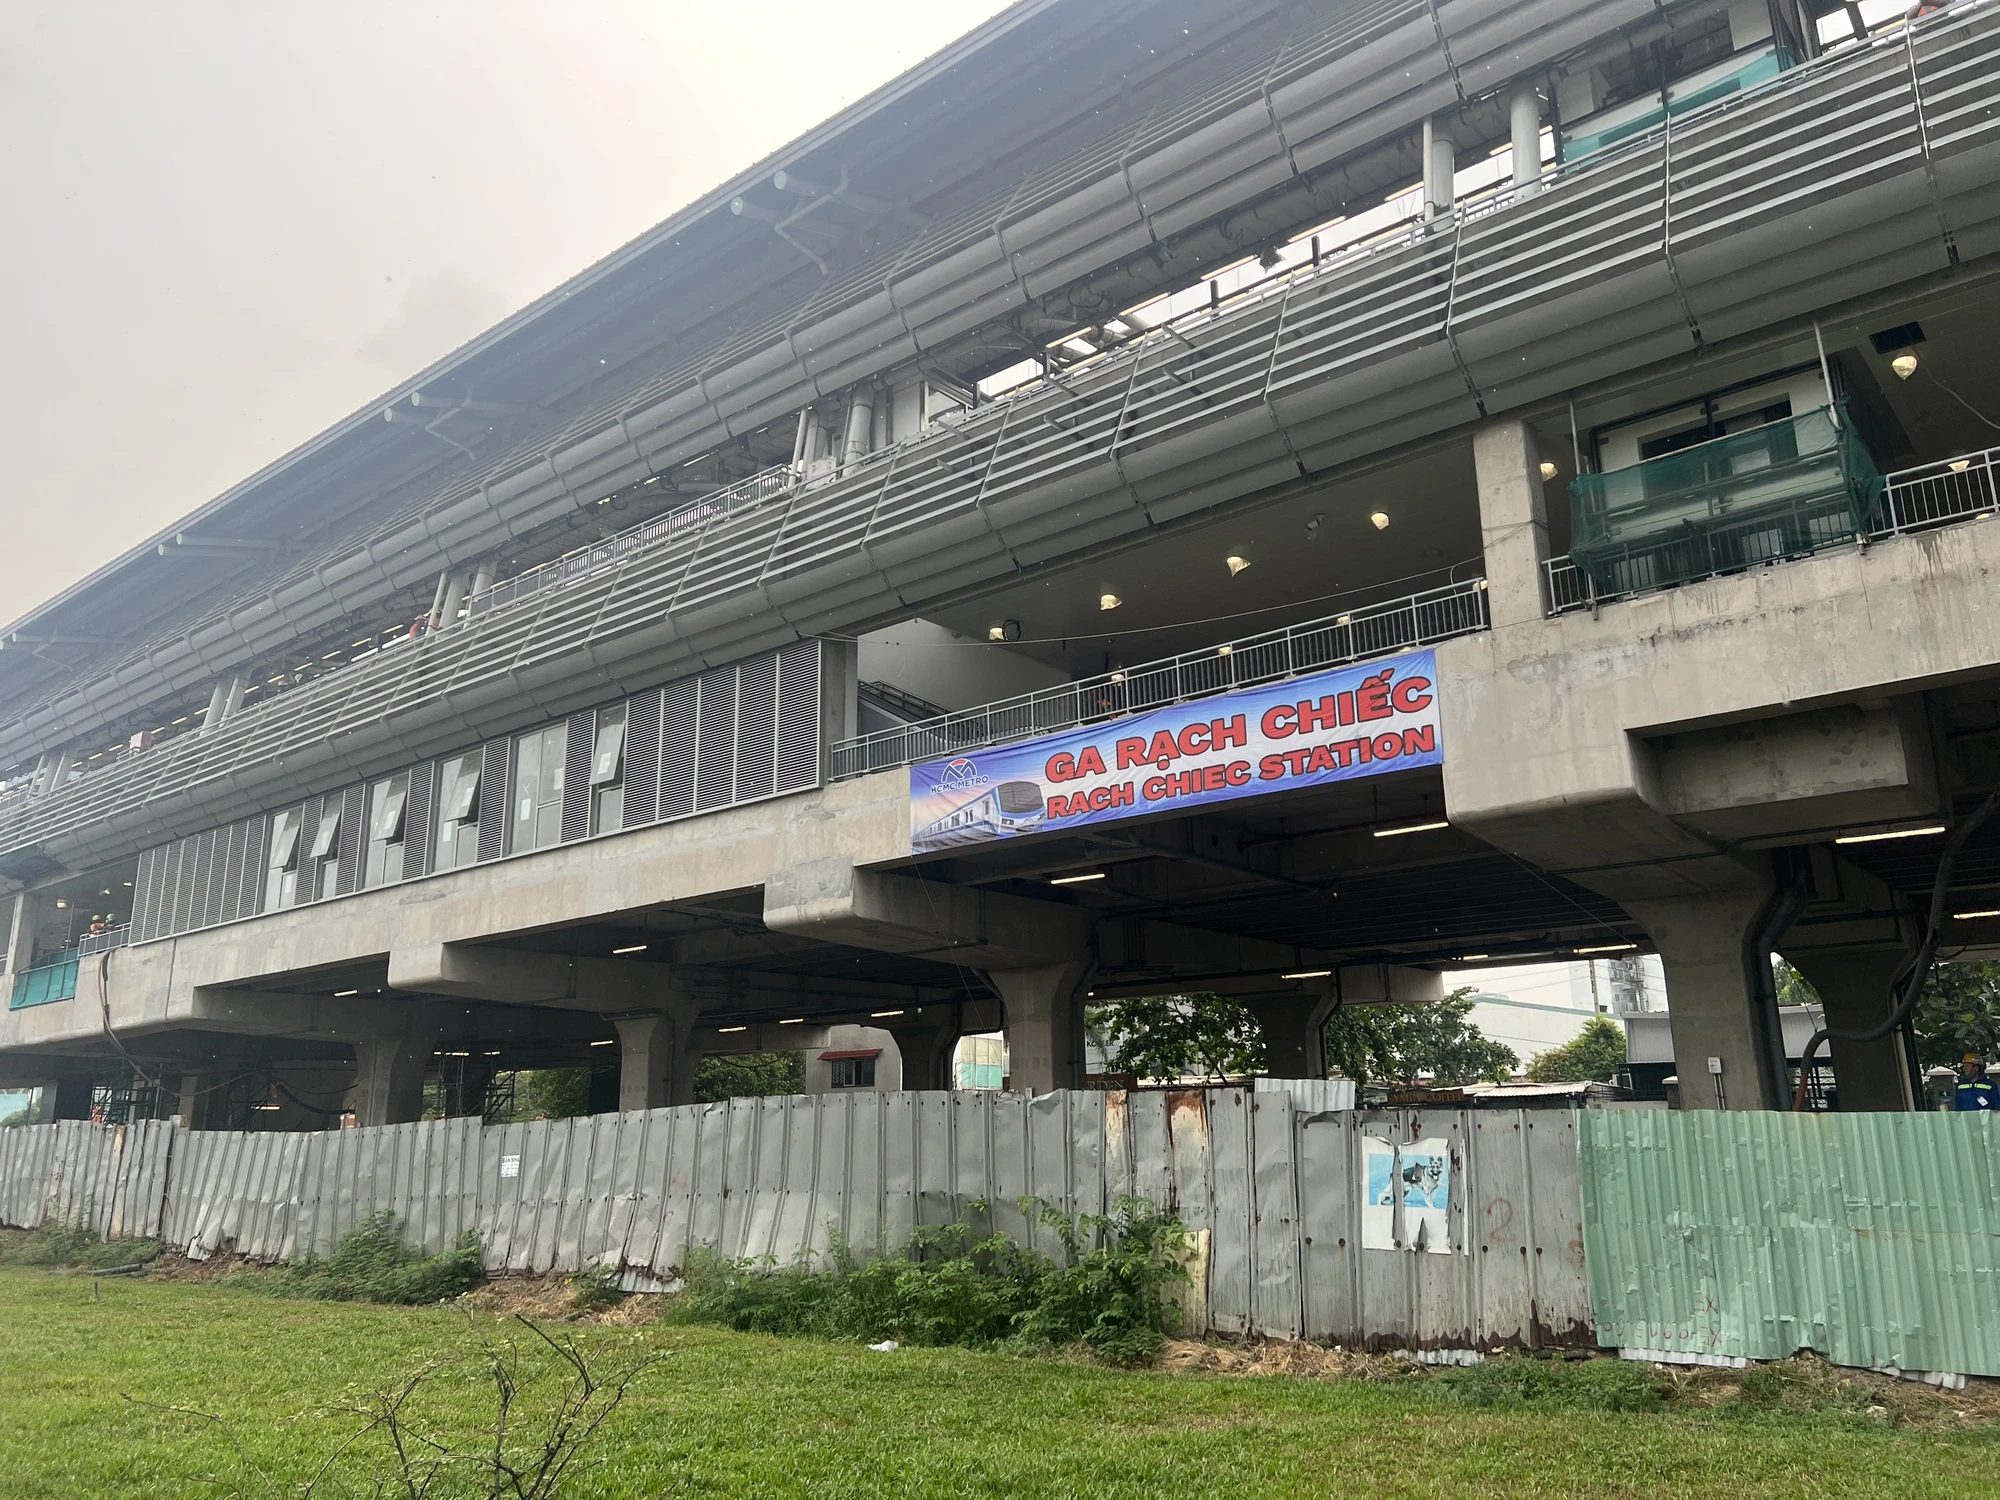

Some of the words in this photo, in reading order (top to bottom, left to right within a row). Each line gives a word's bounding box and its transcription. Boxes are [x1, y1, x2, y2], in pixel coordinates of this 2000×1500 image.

[1045, 745, 1107, 783] GA
[1116, 713, 1247, 771] RẠCH
[1261, 668, 1432, 739] CHIẾC
[931, 782, 956, 794] HCMC
[957, 775, 989, 788] METRO
[1047, 781, 1134, 819] RACH
[1142, 760, 1251, 800] CHIEC
[1259, 725, 1435, 780] STATION
[1425, 1092, 1464, 1102] COFFEE
[1486, 1196, 1515, 1242] 2
